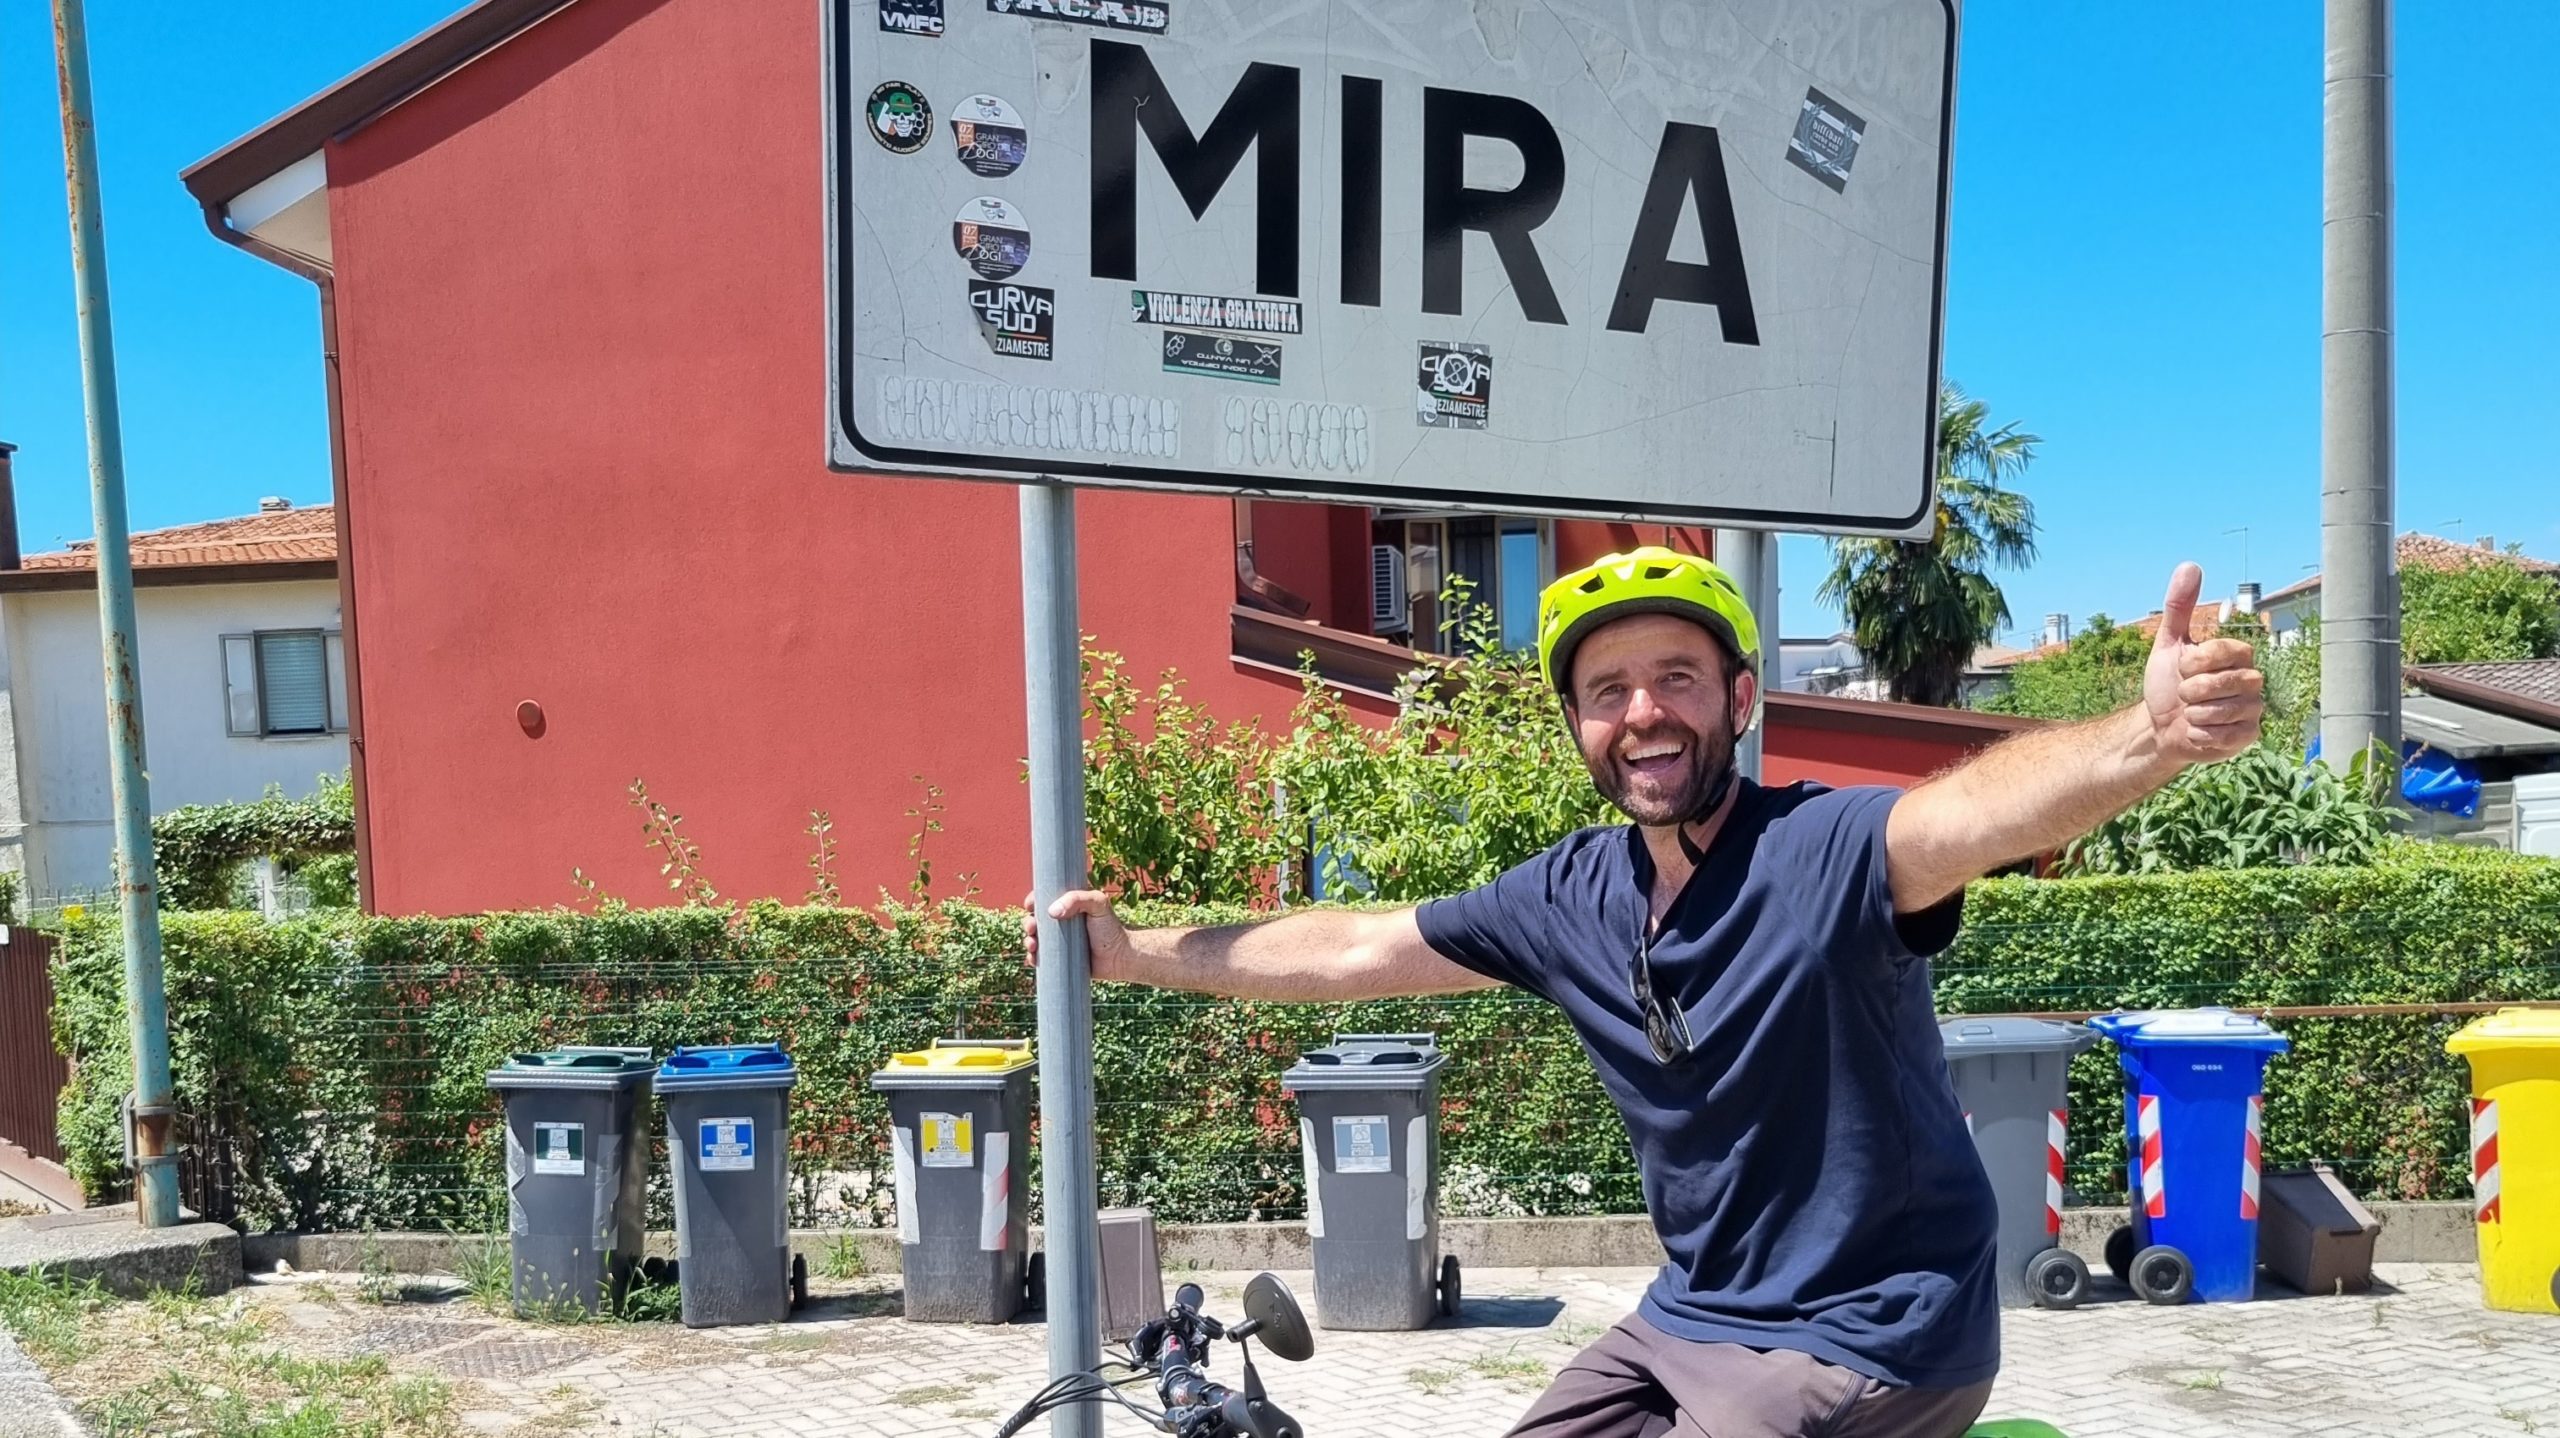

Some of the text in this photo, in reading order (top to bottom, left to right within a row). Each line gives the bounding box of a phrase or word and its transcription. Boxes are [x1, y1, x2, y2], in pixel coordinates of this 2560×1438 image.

[881, 11, 943, 32] VMFC
[959, 123, 973, 133] 07
[975, 132, 1000, 142] GRAN
[1091, 38, 1760, 346] MIRA
[964, 225, 977, 236] 07
[979, 234, 1003, 244] GRAN
[970, 286, 1053, 316] CURVA
[1147, 292, 1299, 333] VIOLENZA GRATUITA
[986, 309, 1037, 334] SUD
[995, 337, 1050, 358] ZIAMESTRE
[1197, 352, 1232, 363] VANTO
[1181, 360, 1220, 371] DIFFIDA
[1223, 364, 1246, 373] OGNI
